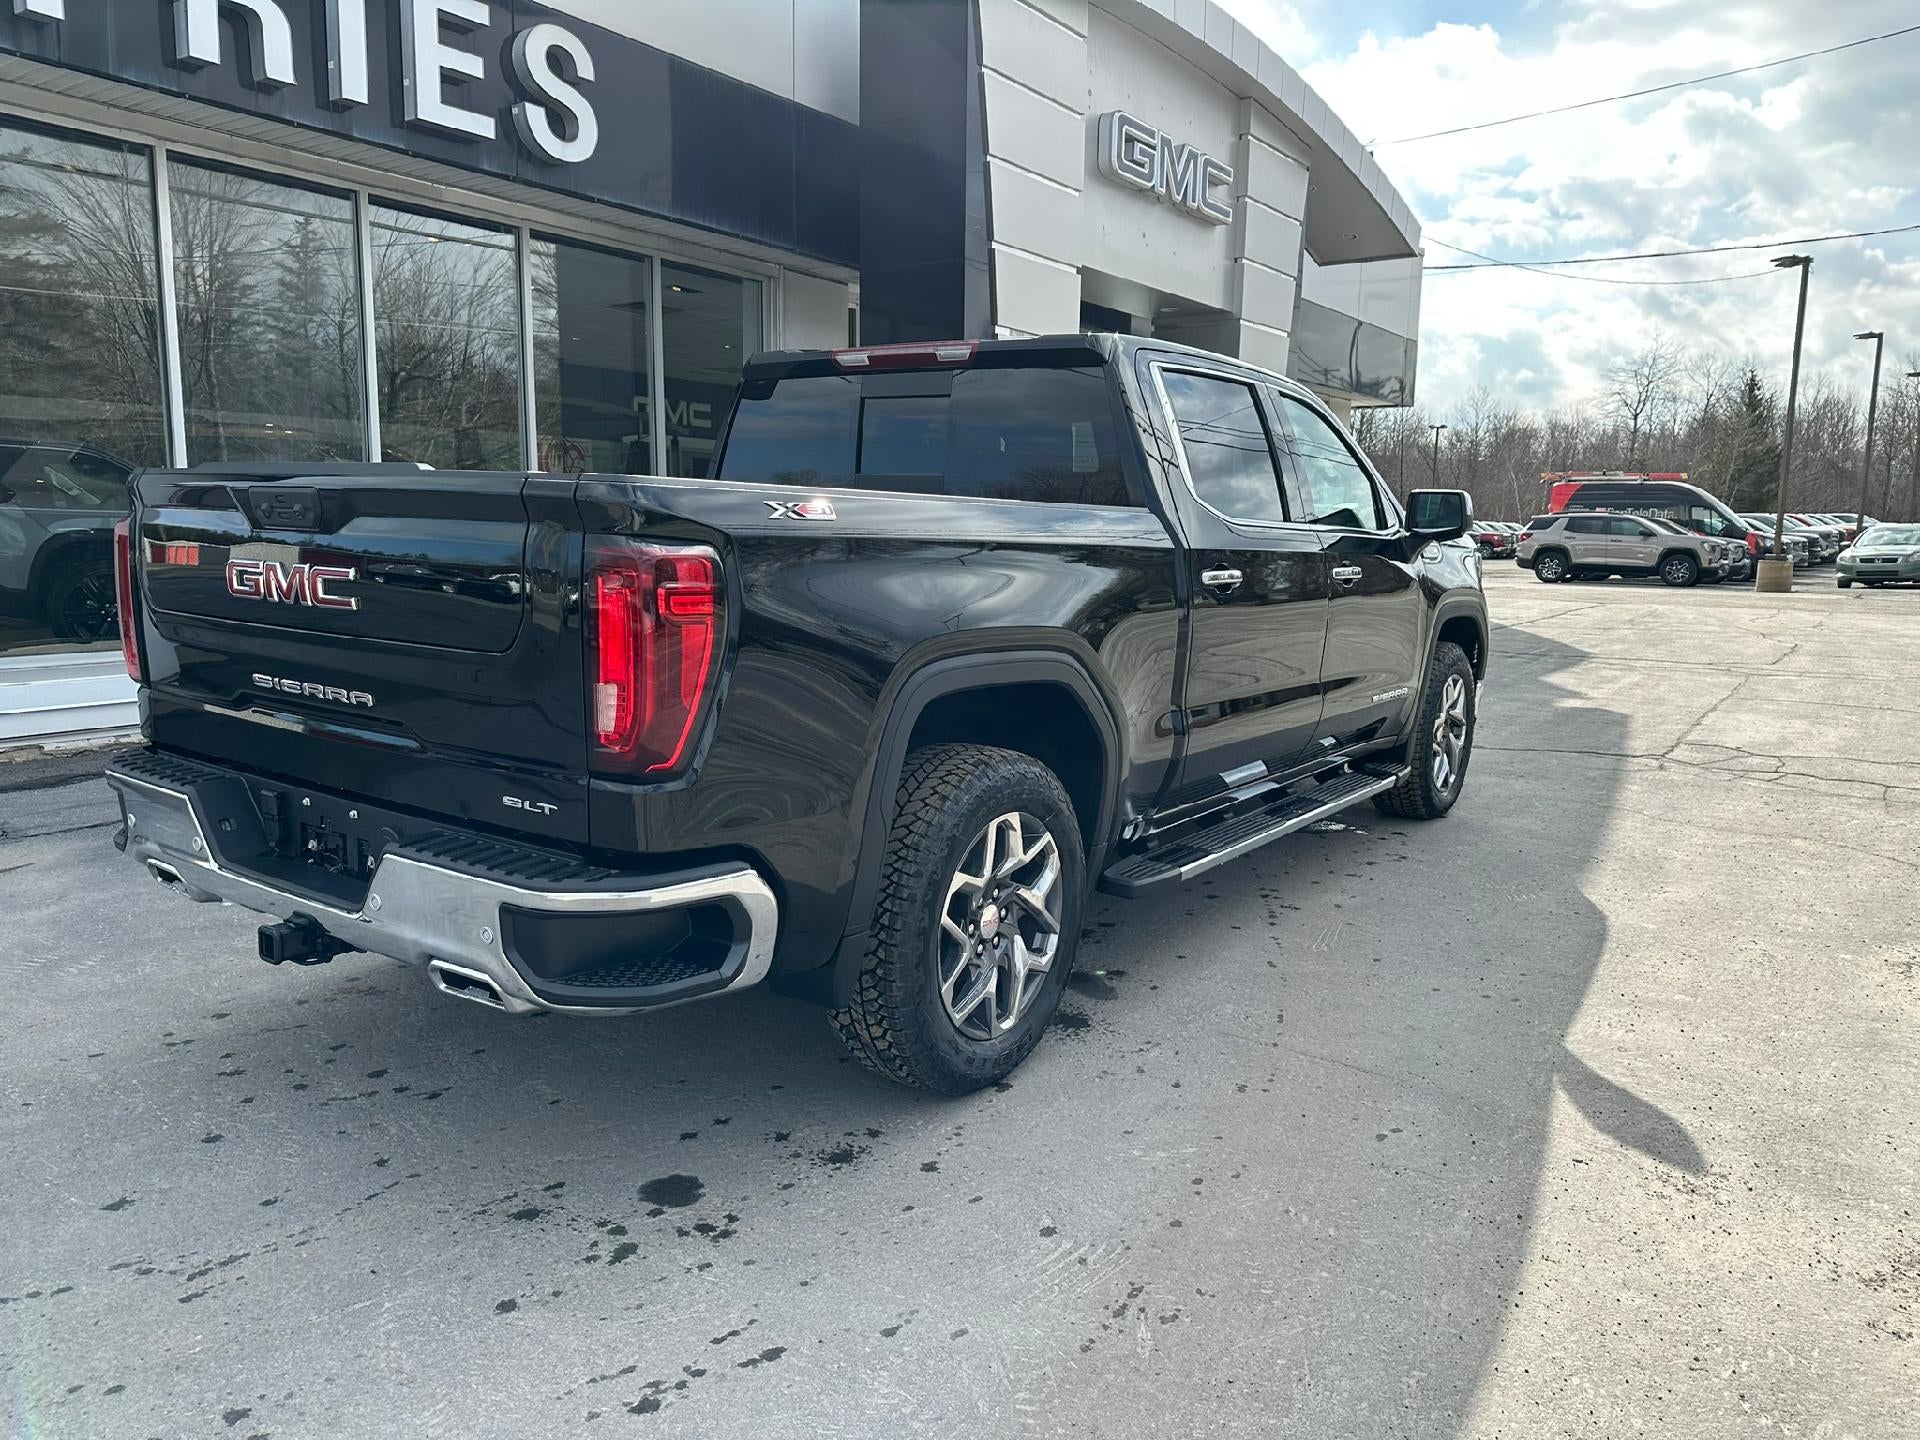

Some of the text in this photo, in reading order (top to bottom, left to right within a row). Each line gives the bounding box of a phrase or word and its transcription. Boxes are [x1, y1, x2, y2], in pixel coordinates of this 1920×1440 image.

[13, 0, 600, 164] IES
[1098, 110, 1234, 226] GMC
[225, 559, 362, 611] GMC
[252, 672, 375, 708] SIERRA
[1371, 687, 1409, 702] SIERRA
[502, 795, 559, 816] SLT
